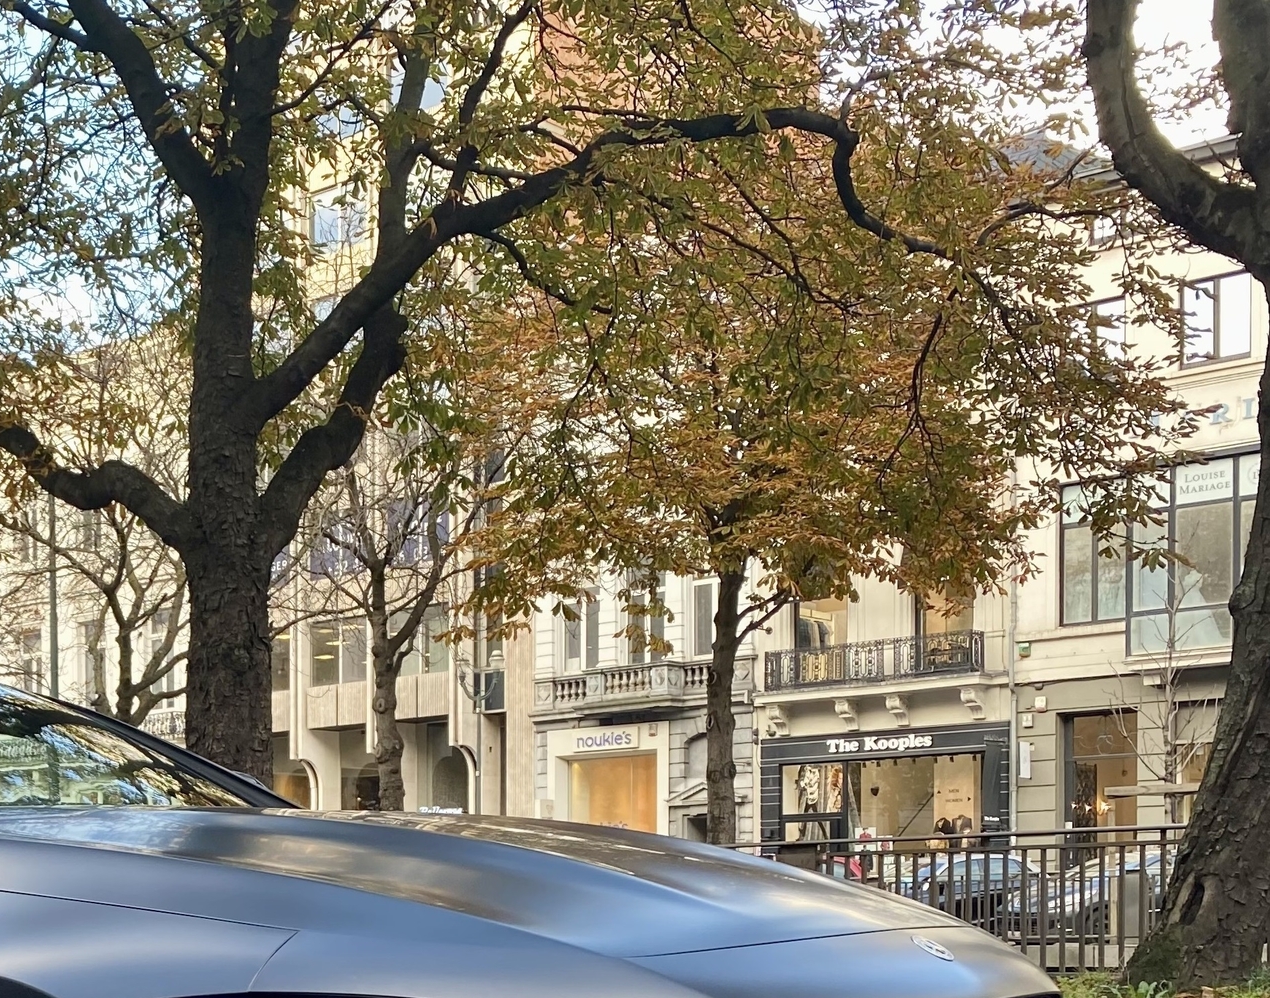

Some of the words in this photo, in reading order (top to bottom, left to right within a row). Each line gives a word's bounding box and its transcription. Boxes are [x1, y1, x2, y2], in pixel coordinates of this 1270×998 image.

[1179, 481, 1231, 495] MARIAGE
[576, 731, 632, 748] noukie's
[826, 738, 860, 753] The
[863, 734, 933, 752] Kooples
